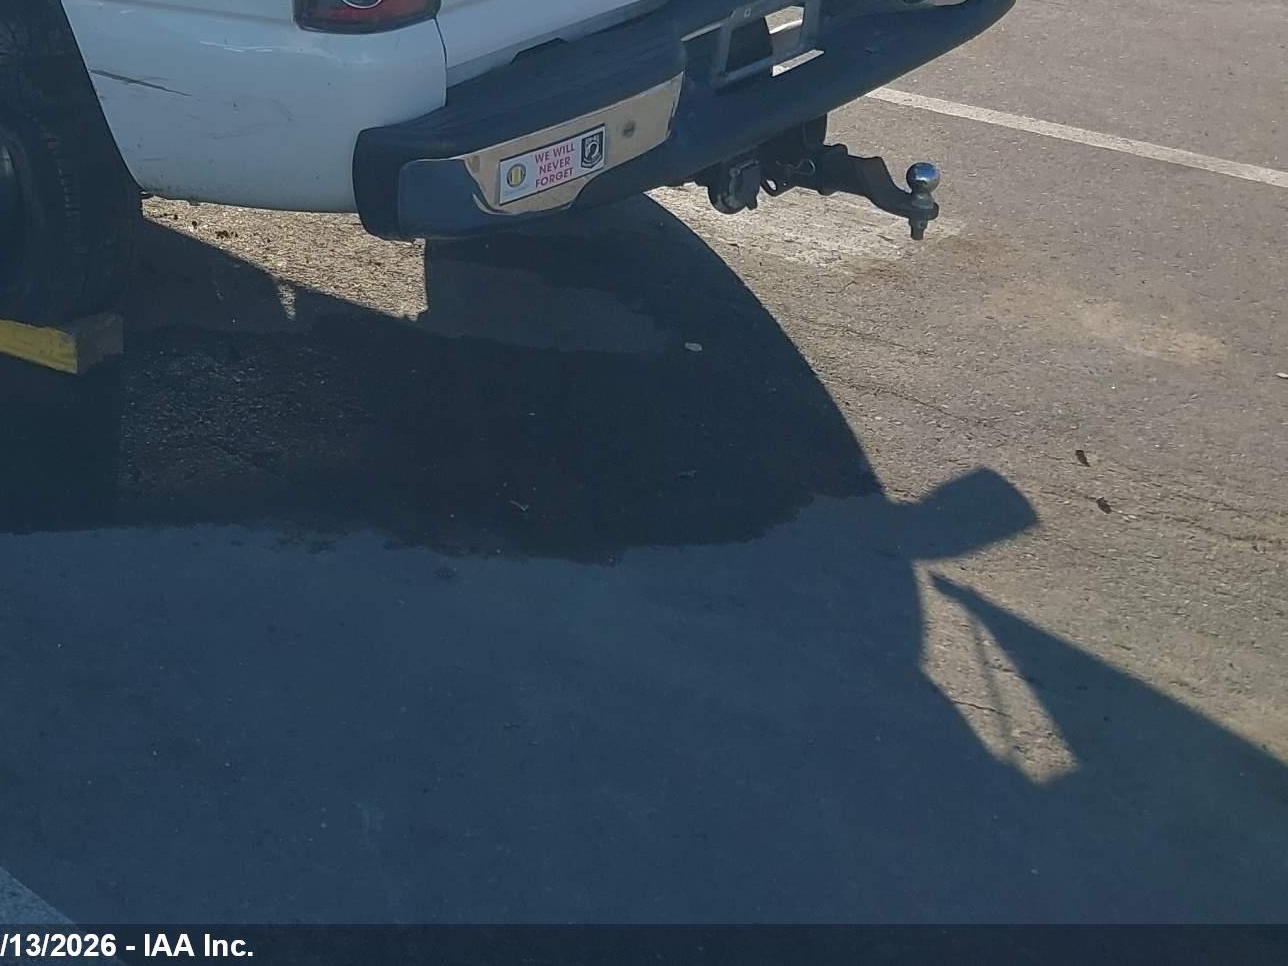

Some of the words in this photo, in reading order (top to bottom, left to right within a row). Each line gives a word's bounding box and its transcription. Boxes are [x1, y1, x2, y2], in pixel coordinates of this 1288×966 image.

[534, 152, 550, 164] WE
[552, 142, 575, 157] WILL
[539, 156, 571, 175] NEVER
[535, 168, 573, 188] FORGET
